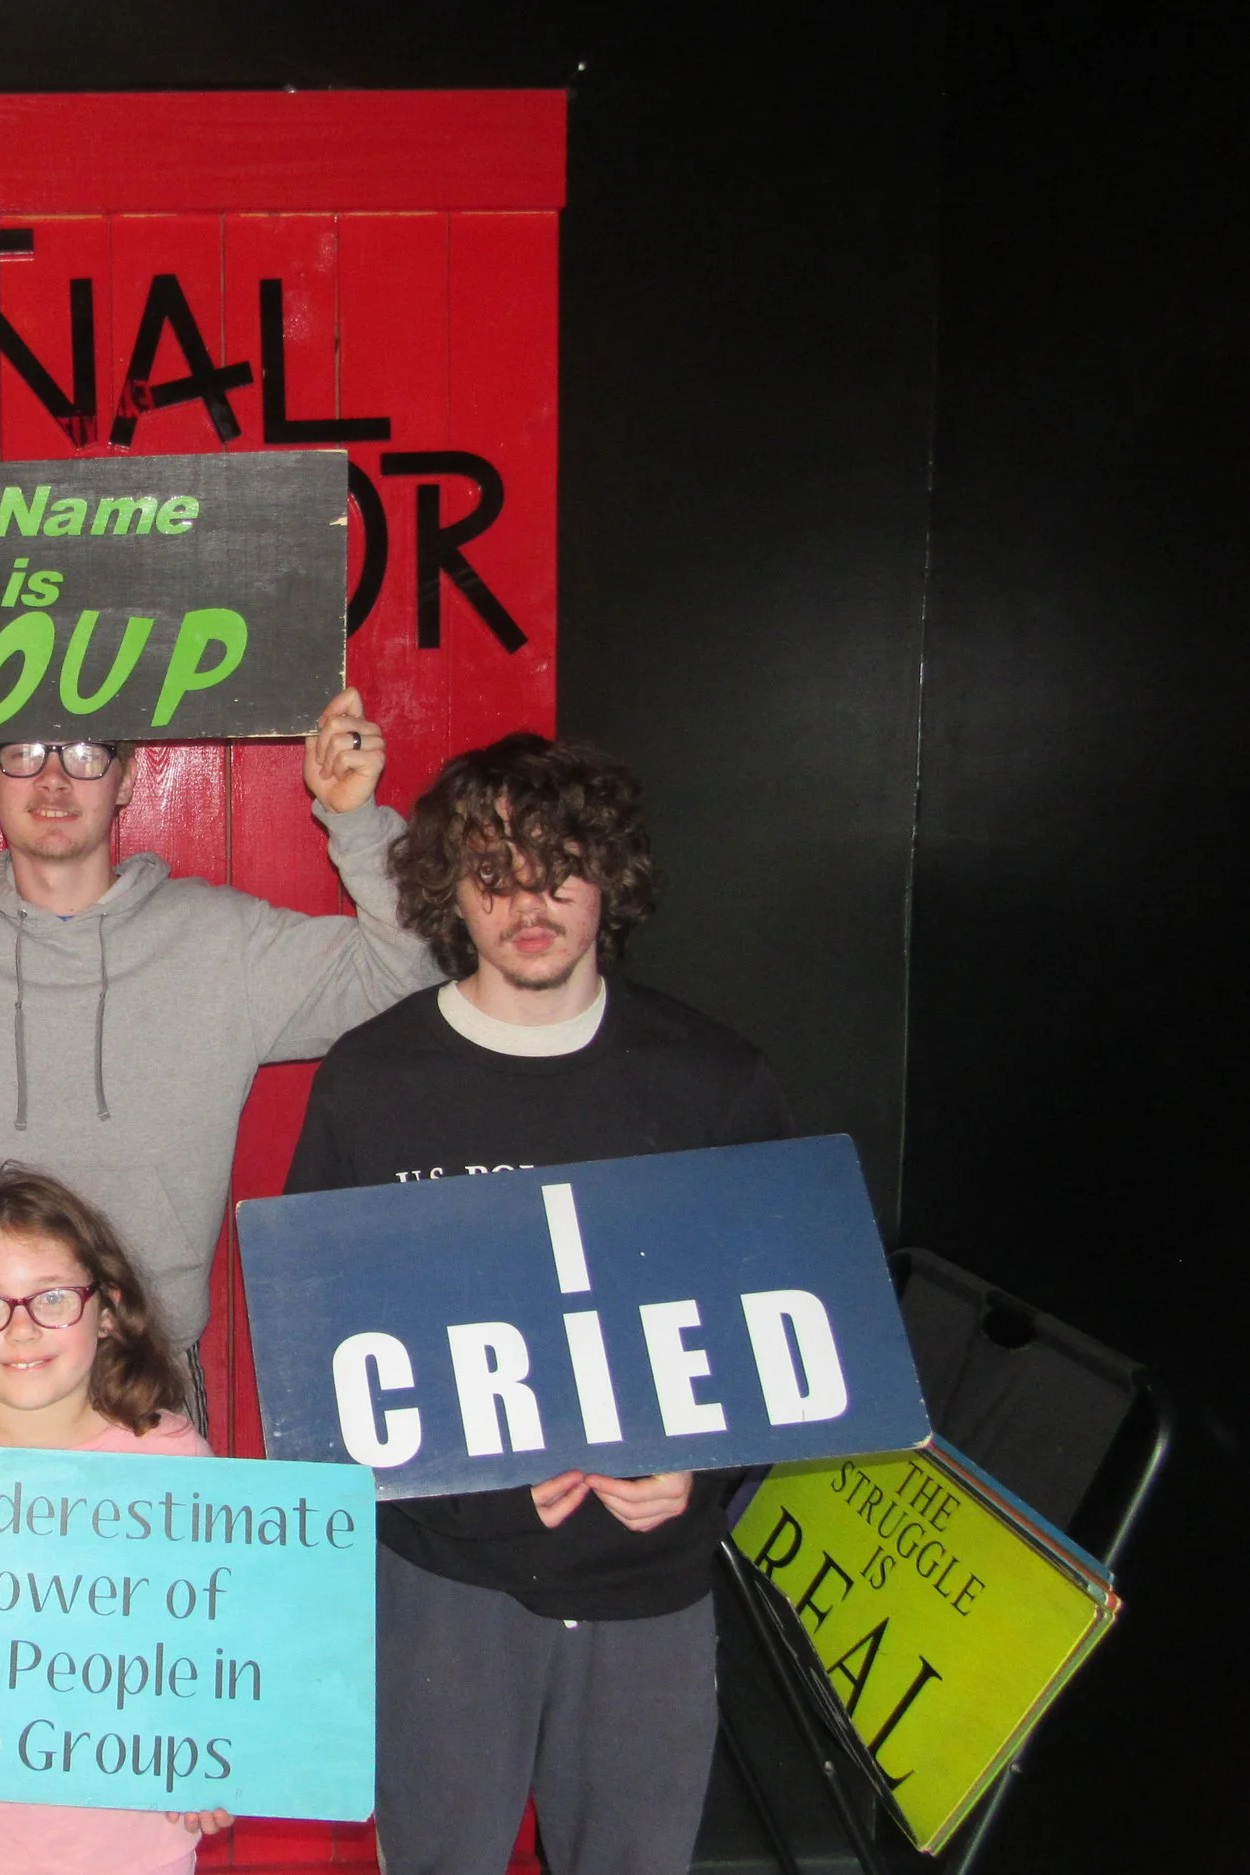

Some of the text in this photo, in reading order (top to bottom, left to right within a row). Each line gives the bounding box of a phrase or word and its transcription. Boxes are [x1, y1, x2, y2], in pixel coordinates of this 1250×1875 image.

[1, 559, 63, 607] is
[541, 1183, 592, 1294] I
[331, 1289, 848, 1468] CRIED
[894, 1460, 961, 1533] THE
[831, 1460, 985, 1616] STRUGGLE
[859, 1545, 896, 1591] IS
[165, 1567, 231, 1621] of
[9, 1639, 198, 1710] People
[214, 1649, 261, 1700] in
[18, 1719, 233, 1793] Groups
